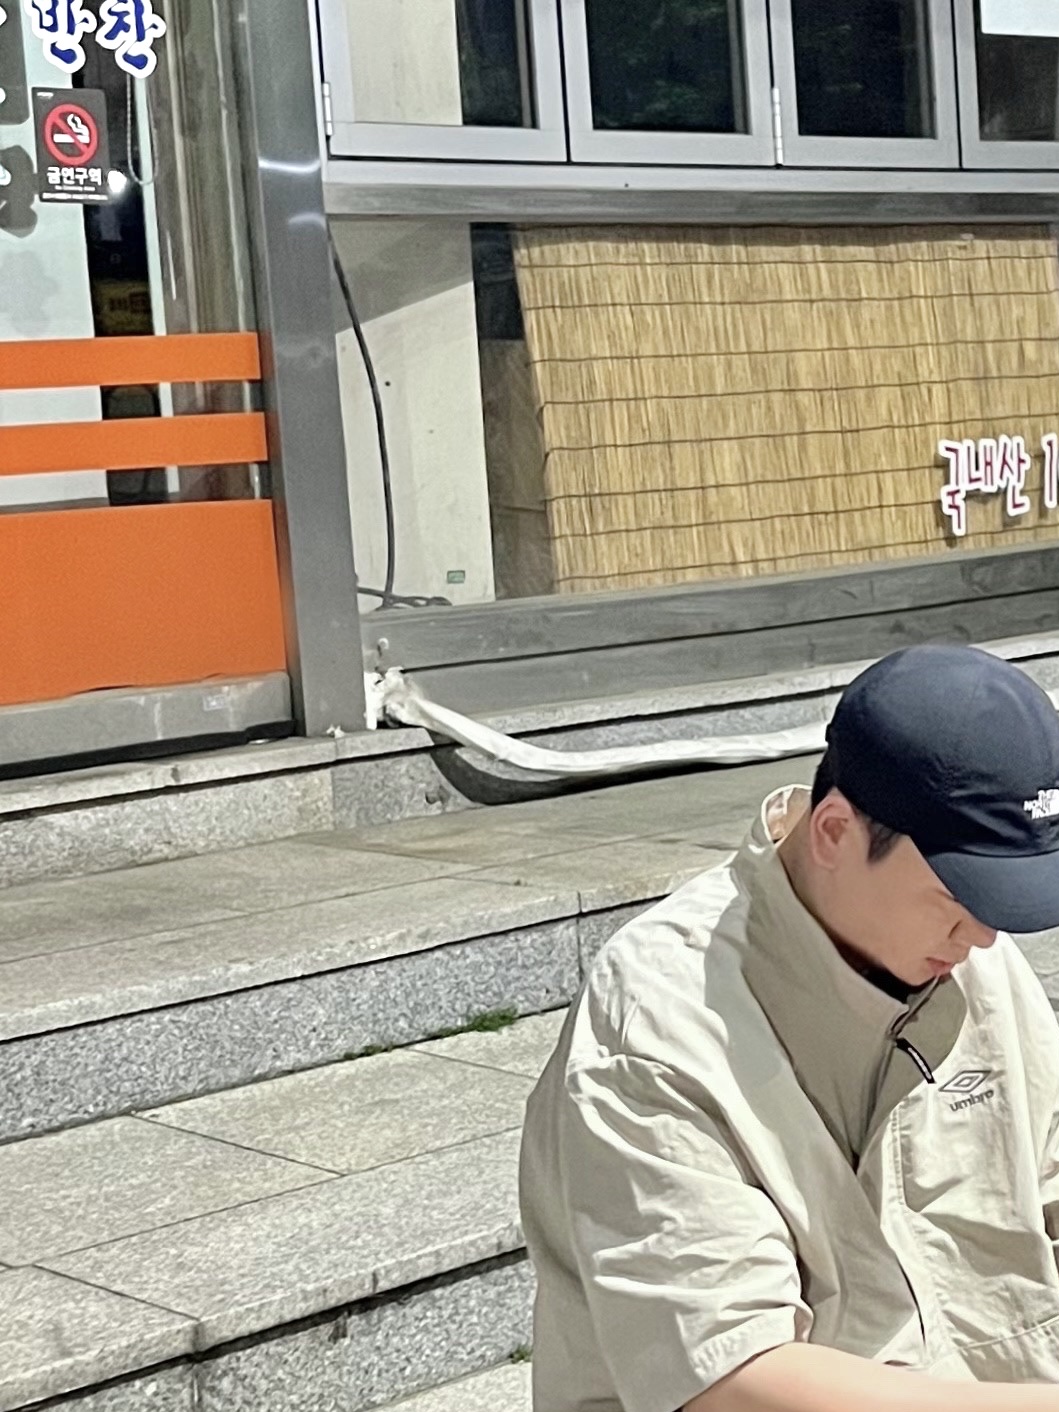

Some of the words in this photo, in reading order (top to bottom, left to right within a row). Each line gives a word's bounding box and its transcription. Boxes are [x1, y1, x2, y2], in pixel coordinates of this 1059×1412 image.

[46, 166, 102, 186] 금연구역
[940, 436, 1031, 534] 국내산
[949, 1089, 995, 1112] umbro
